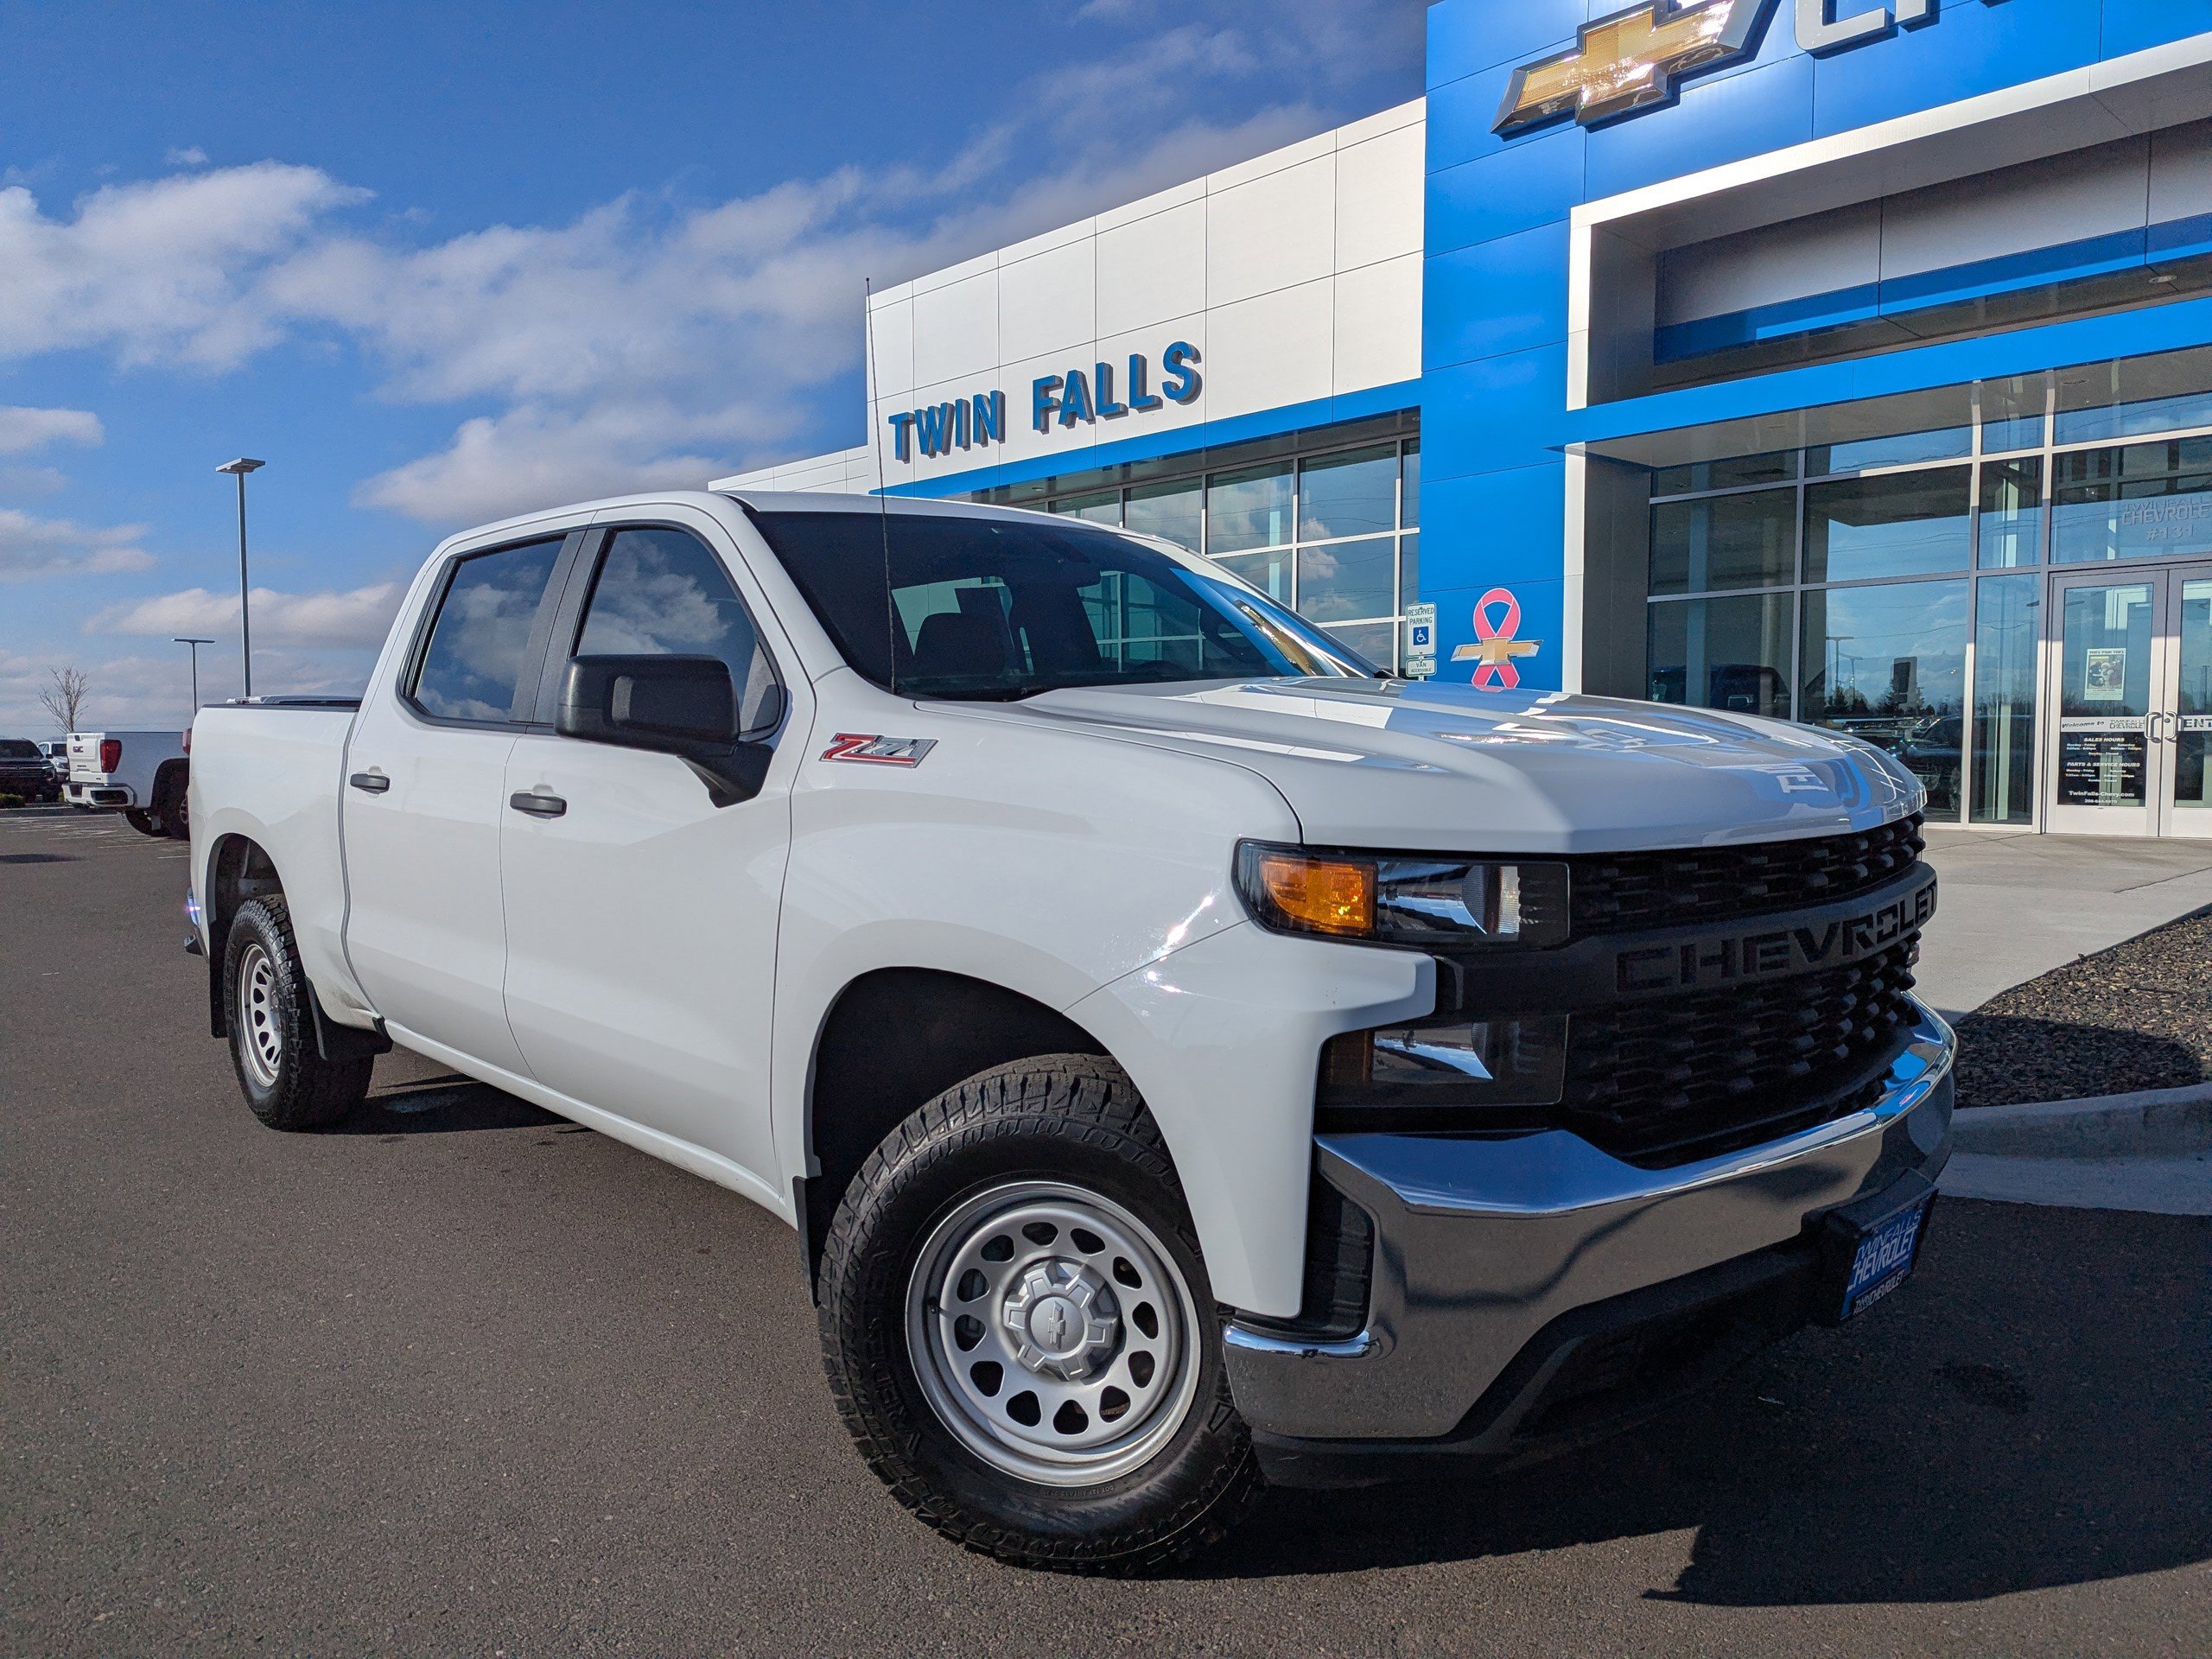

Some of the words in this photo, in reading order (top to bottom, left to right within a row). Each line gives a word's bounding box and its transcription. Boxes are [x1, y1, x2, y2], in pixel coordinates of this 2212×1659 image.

[887, 390, 1006, 464] TWIN
[1032, 340, 1204, 435] FALLS
[2122, 504, 2212, 525] CHEVROLE
[1408, 607, 1434, 616] RESERVED
[819, 733, 939, 769] Z71
[1616, 880, 1937, 993] CHEVROLET
